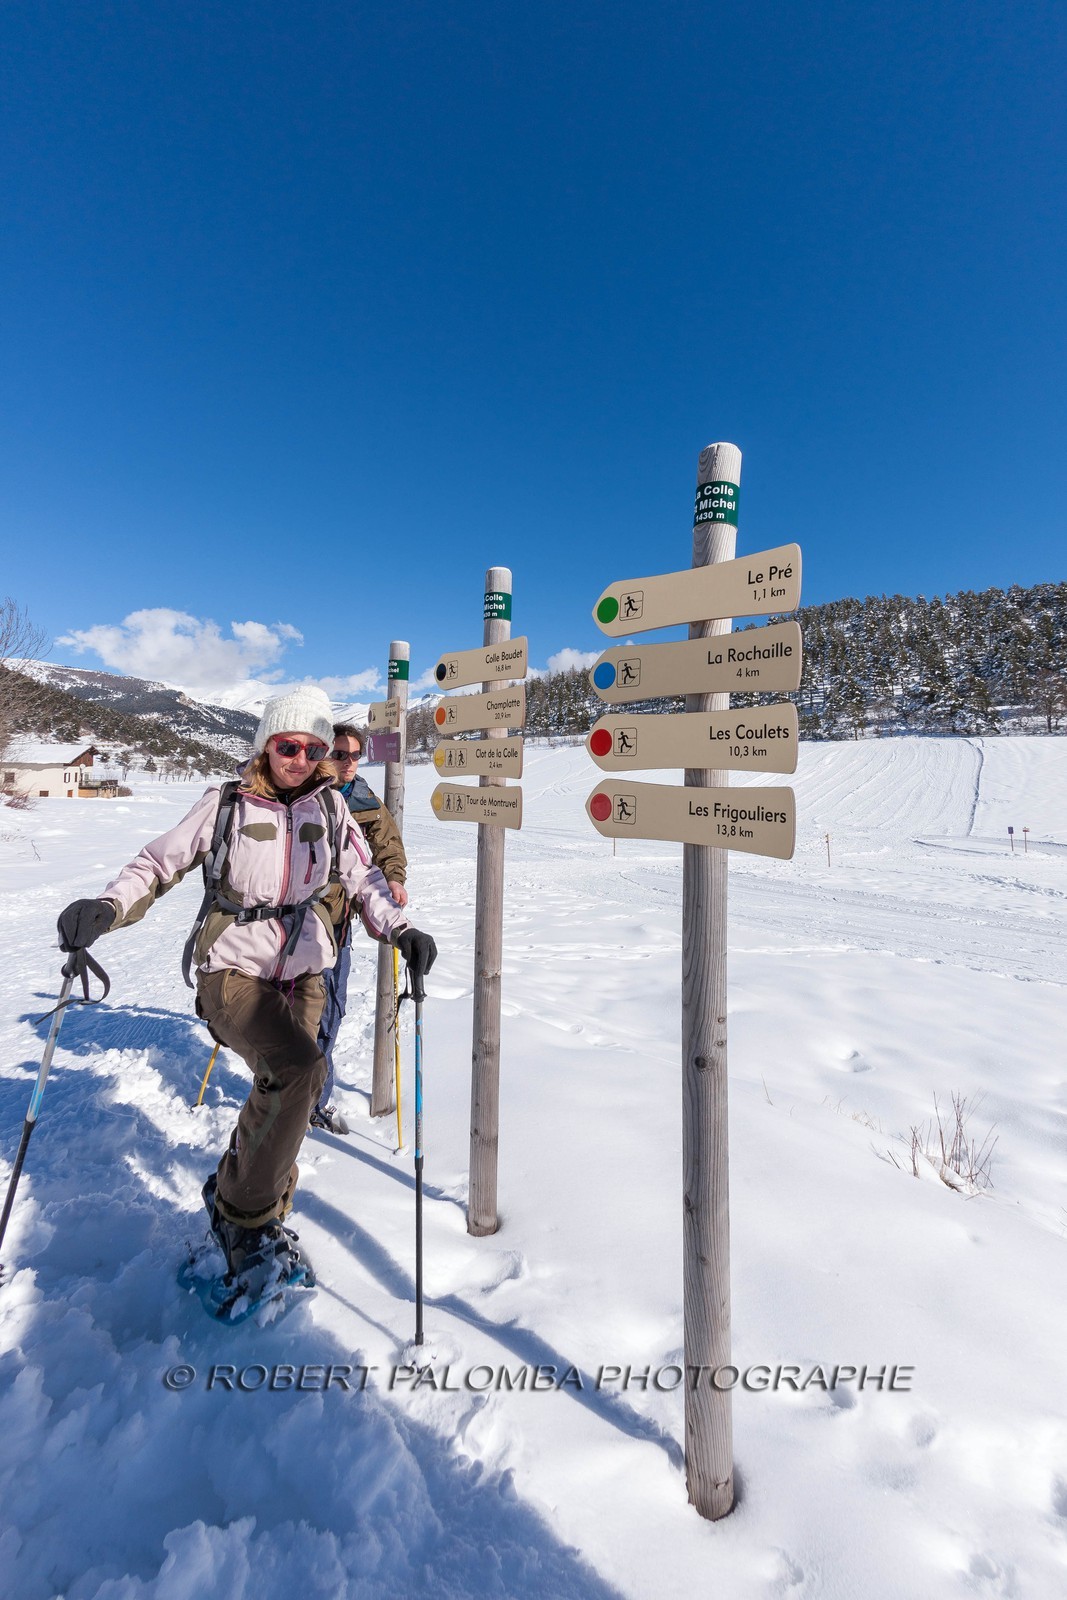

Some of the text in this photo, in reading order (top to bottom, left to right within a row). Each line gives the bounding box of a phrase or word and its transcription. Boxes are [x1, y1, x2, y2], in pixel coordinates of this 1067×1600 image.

[703, 484, 735, 496] Colle
[699, 498, 736, 511] Michel
[695, 511, 714, 523] 1430
[747, 563, 793, 585] Le Pré
[753, 587, 786, 601] 1,1 km
[485, 649, 523, 664] Colle Baudet
[707, 642, 793, 665] La Rochaille
[736, 667, 760, 678] 4 km
[486, 698, 521, 711] Champlatte
[505, 711, 512, 719] km
[709, 724, 790, 740] Les Coulets
[475, 748, 518, 758] Clot de la Colle
[729, 746, 767, 758] 10,3 km
[466, 795, 518, 808] Tour de Montruvel
[689, 801, 787, 823] Les Frigouliers
[717, 824, 754, 838] 13,8 km
